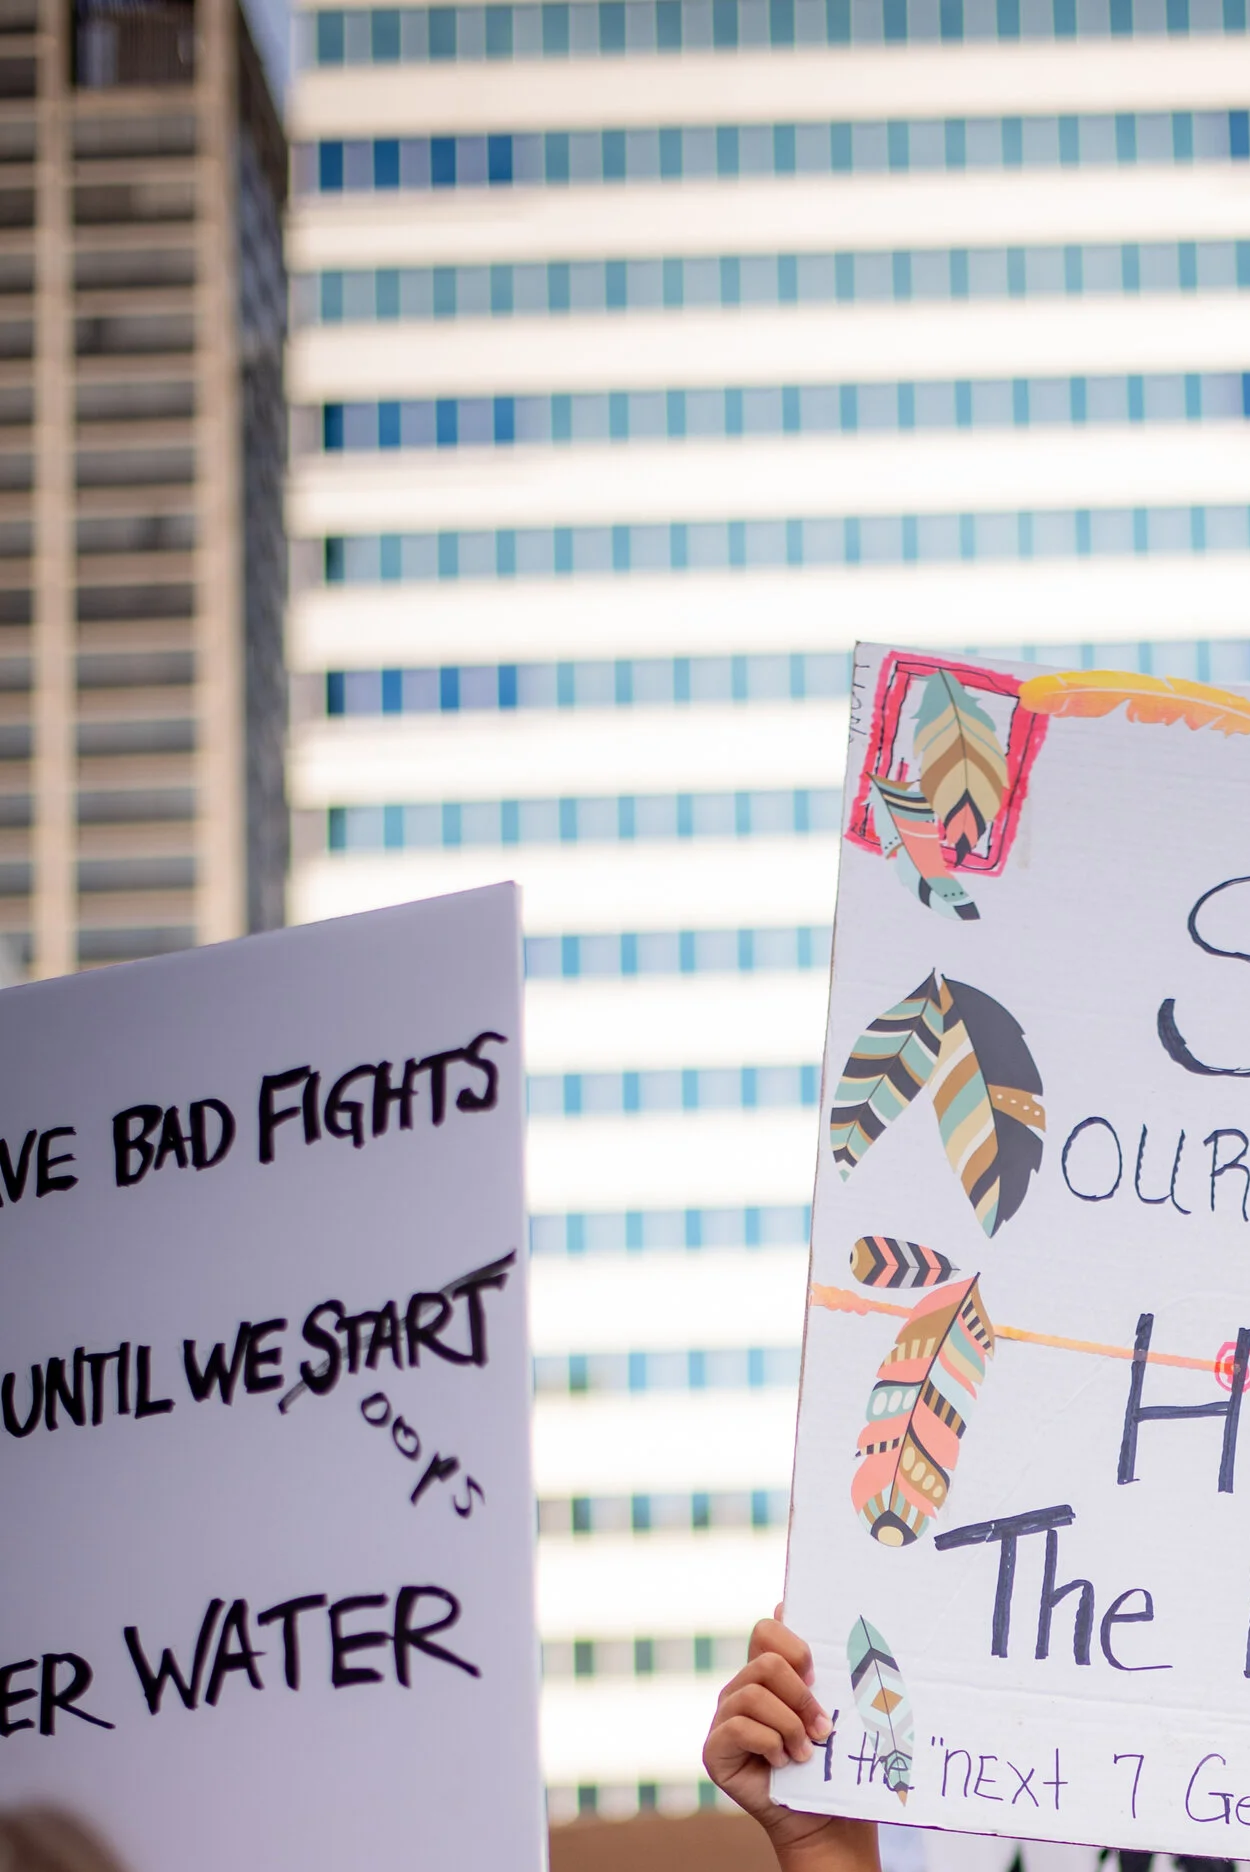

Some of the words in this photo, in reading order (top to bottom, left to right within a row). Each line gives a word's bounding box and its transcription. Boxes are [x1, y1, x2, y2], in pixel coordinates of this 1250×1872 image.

[0, 1126, 79, 1206] VE
[112, 1099, 236, 1187] BAD
[258, 1032, 508, 1164] FIGHTS
[2, 1341, 176, 1439] UNTIL
[183, 1318, 288, 1406] WE
[300, 1272, 510, 1397] START
[124, 1585, 482, 1716] WATER
[934, 1503, 1172, 1672] The
[1114, 1753, 1145, 1819] 7
